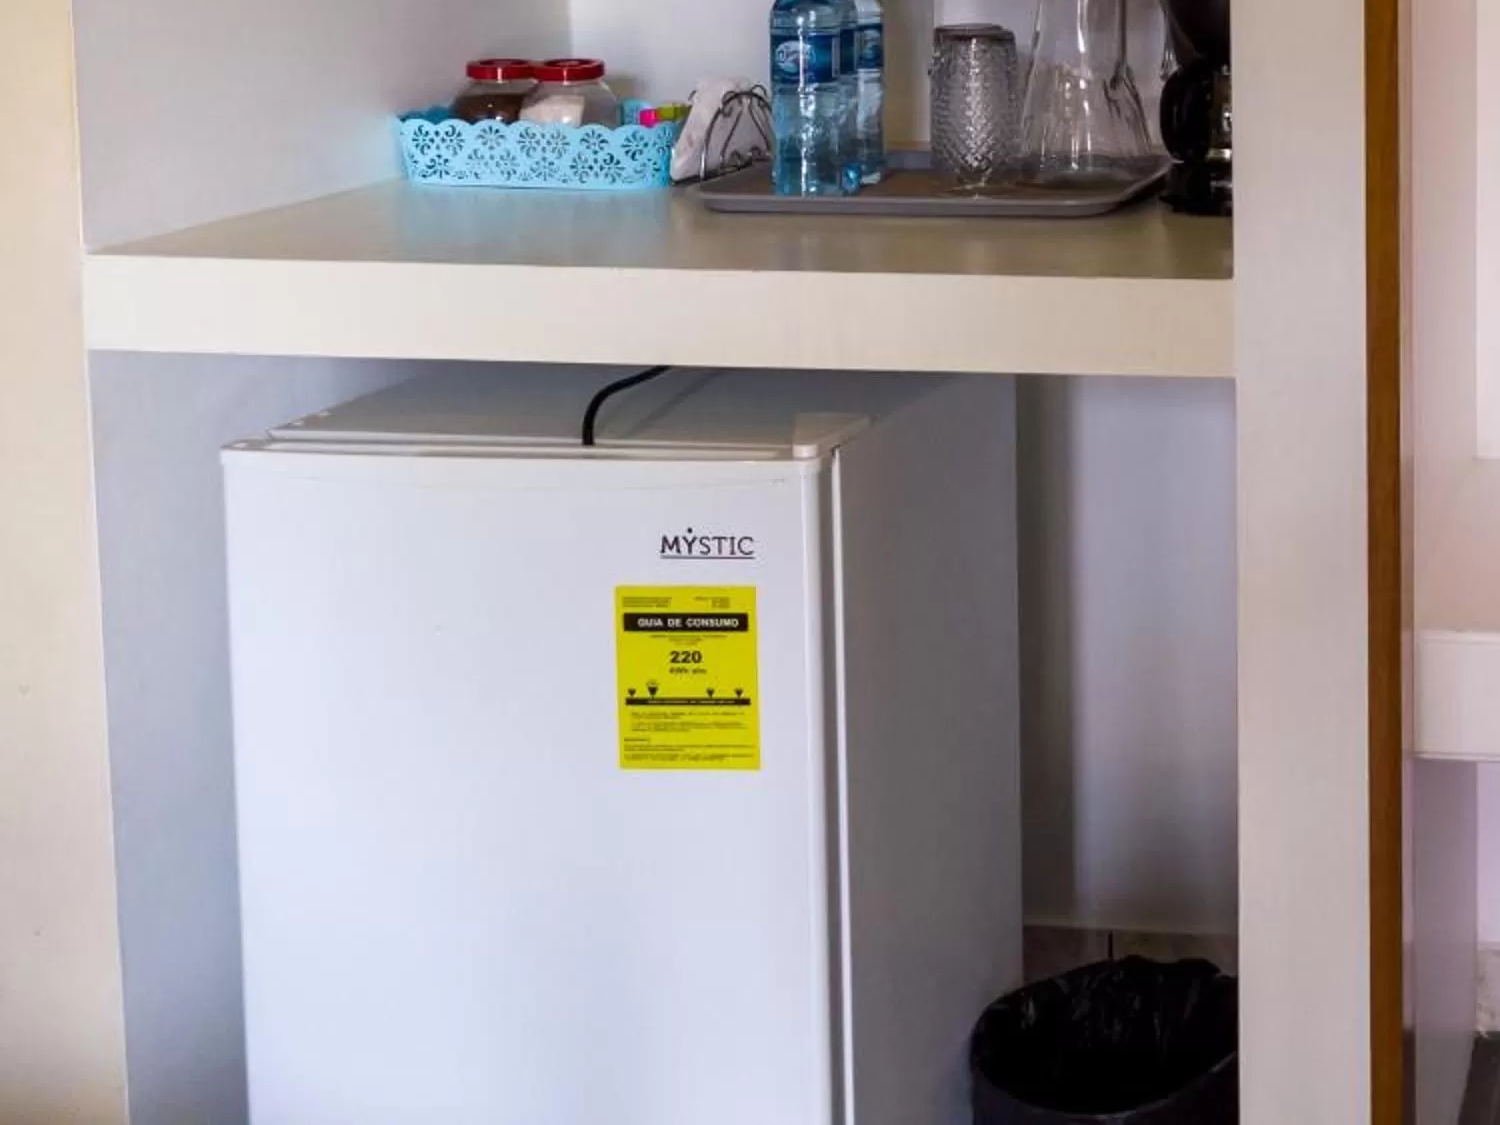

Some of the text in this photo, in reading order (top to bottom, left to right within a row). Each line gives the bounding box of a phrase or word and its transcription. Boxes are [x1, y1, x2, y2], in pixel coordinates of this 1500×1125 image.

[660, 527, 755, 556] MYSTIC
[667, 617, 682, 628] DE
[686, 617, 739, 628] CONSUMO
[669, 650, 702, 664] 220
